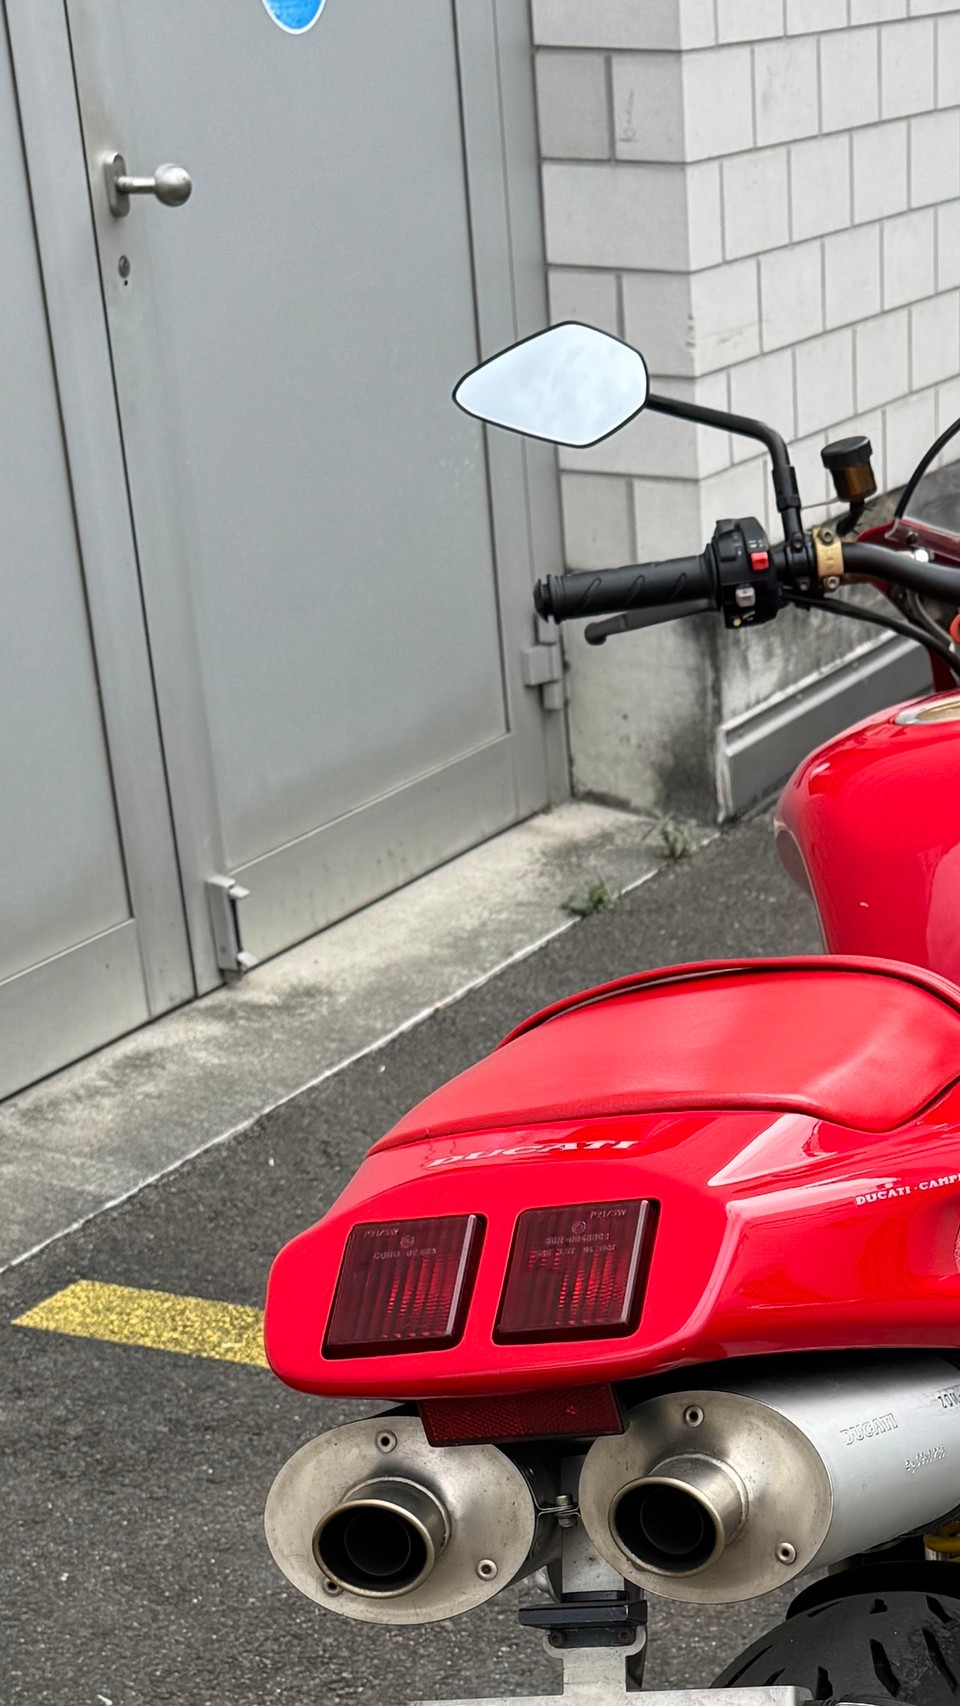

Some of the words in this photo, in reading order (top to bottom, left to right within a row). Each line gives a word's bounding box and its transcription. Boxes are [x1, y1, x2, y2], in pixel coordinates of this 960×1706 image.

[423, 1140, 639, 1169] DUCATI
[855, 1185, 911, 1206] DUCATI
[840, 1412, 899, 1446] DUCATI
